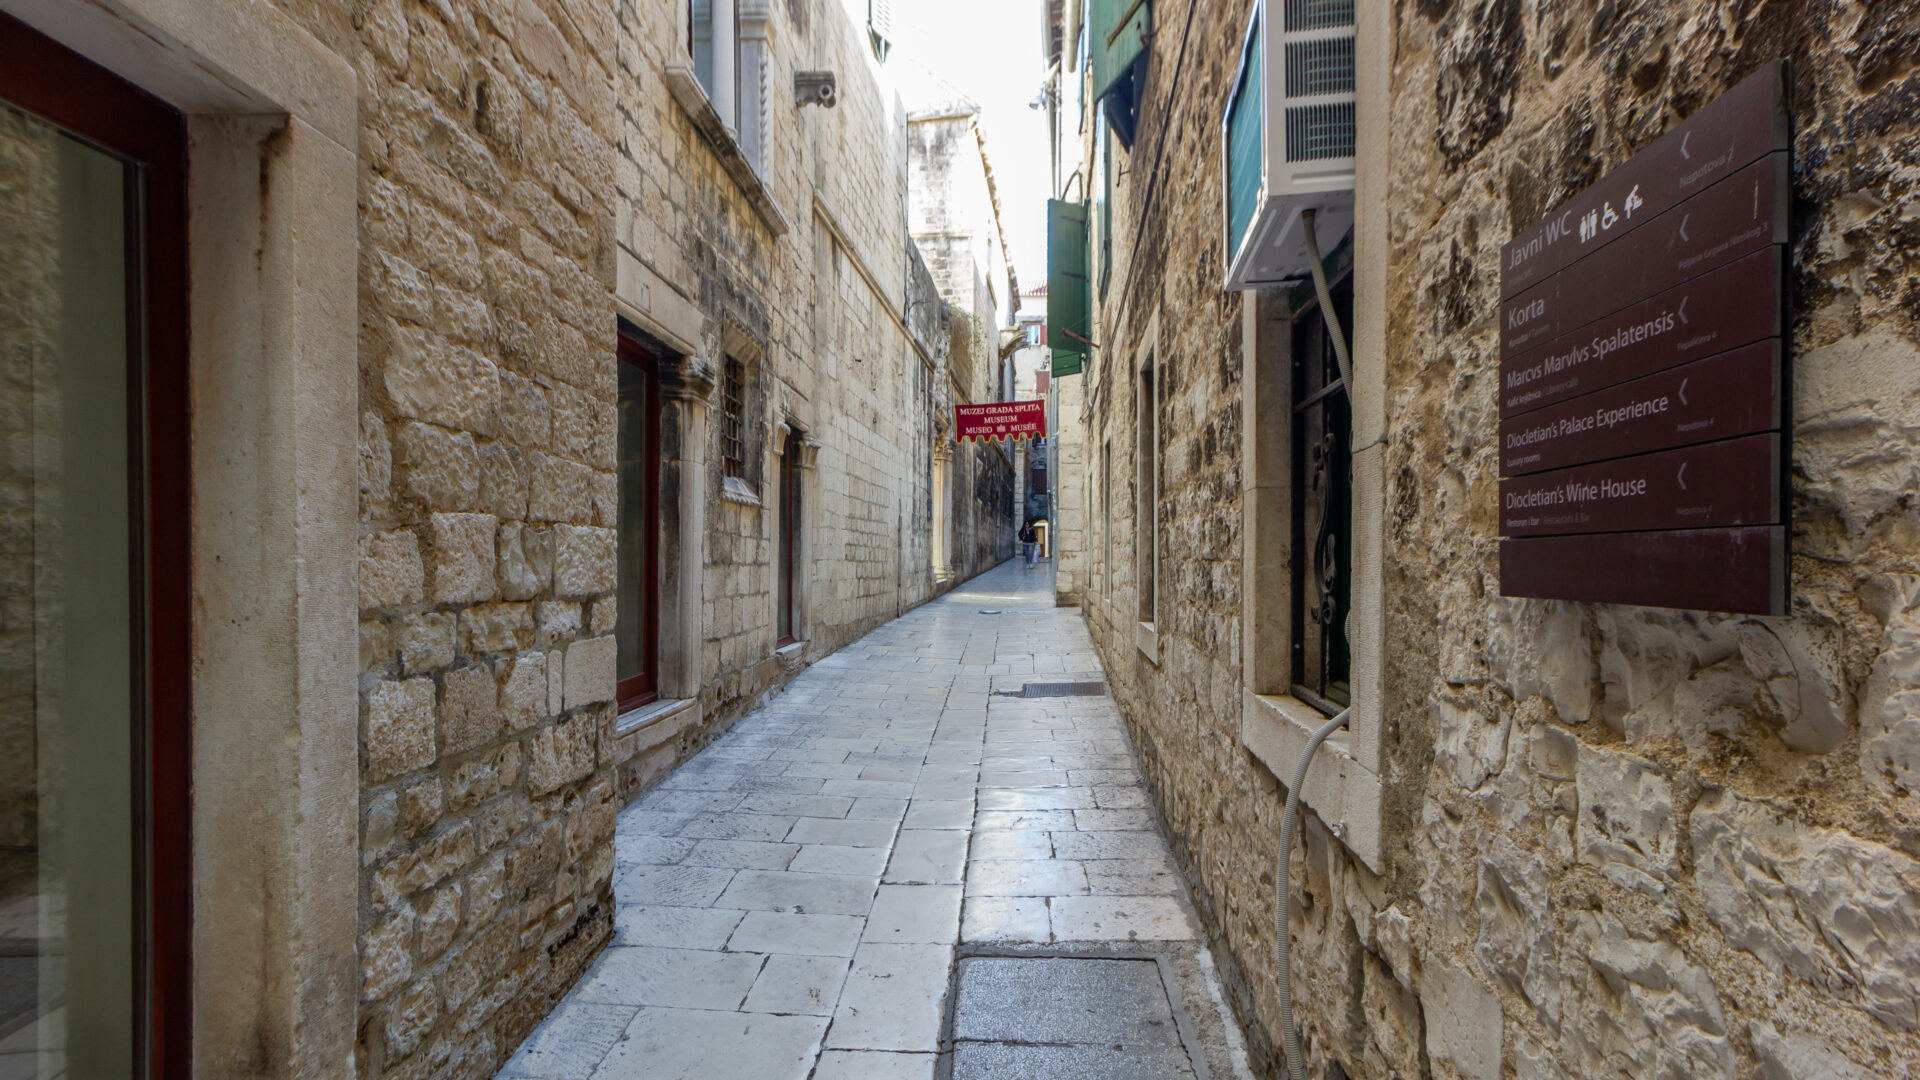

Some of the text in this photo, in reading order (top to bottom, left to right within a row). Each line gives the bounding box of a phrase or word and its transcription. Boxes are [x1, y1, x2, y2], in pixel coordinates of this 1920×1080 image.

[1508, 209, 1572, 271] Javni WC
[1508, 297, 1545, 331] Korta
[1506, 310, 1675, 390] Marcvs Marvlvs Spalatensis
[960, 403, 1041, 416] MUZEJ GRADA SPLITA
[984, 415, 1018, 424] MUSEUM
[1506, 395, 1669, 449] Diocletian's Palace Experience
[965, 422, 1037, 434] MUSEO MUSÉE
[1506, 478, 1647, 510] Diocletian's Wine House
